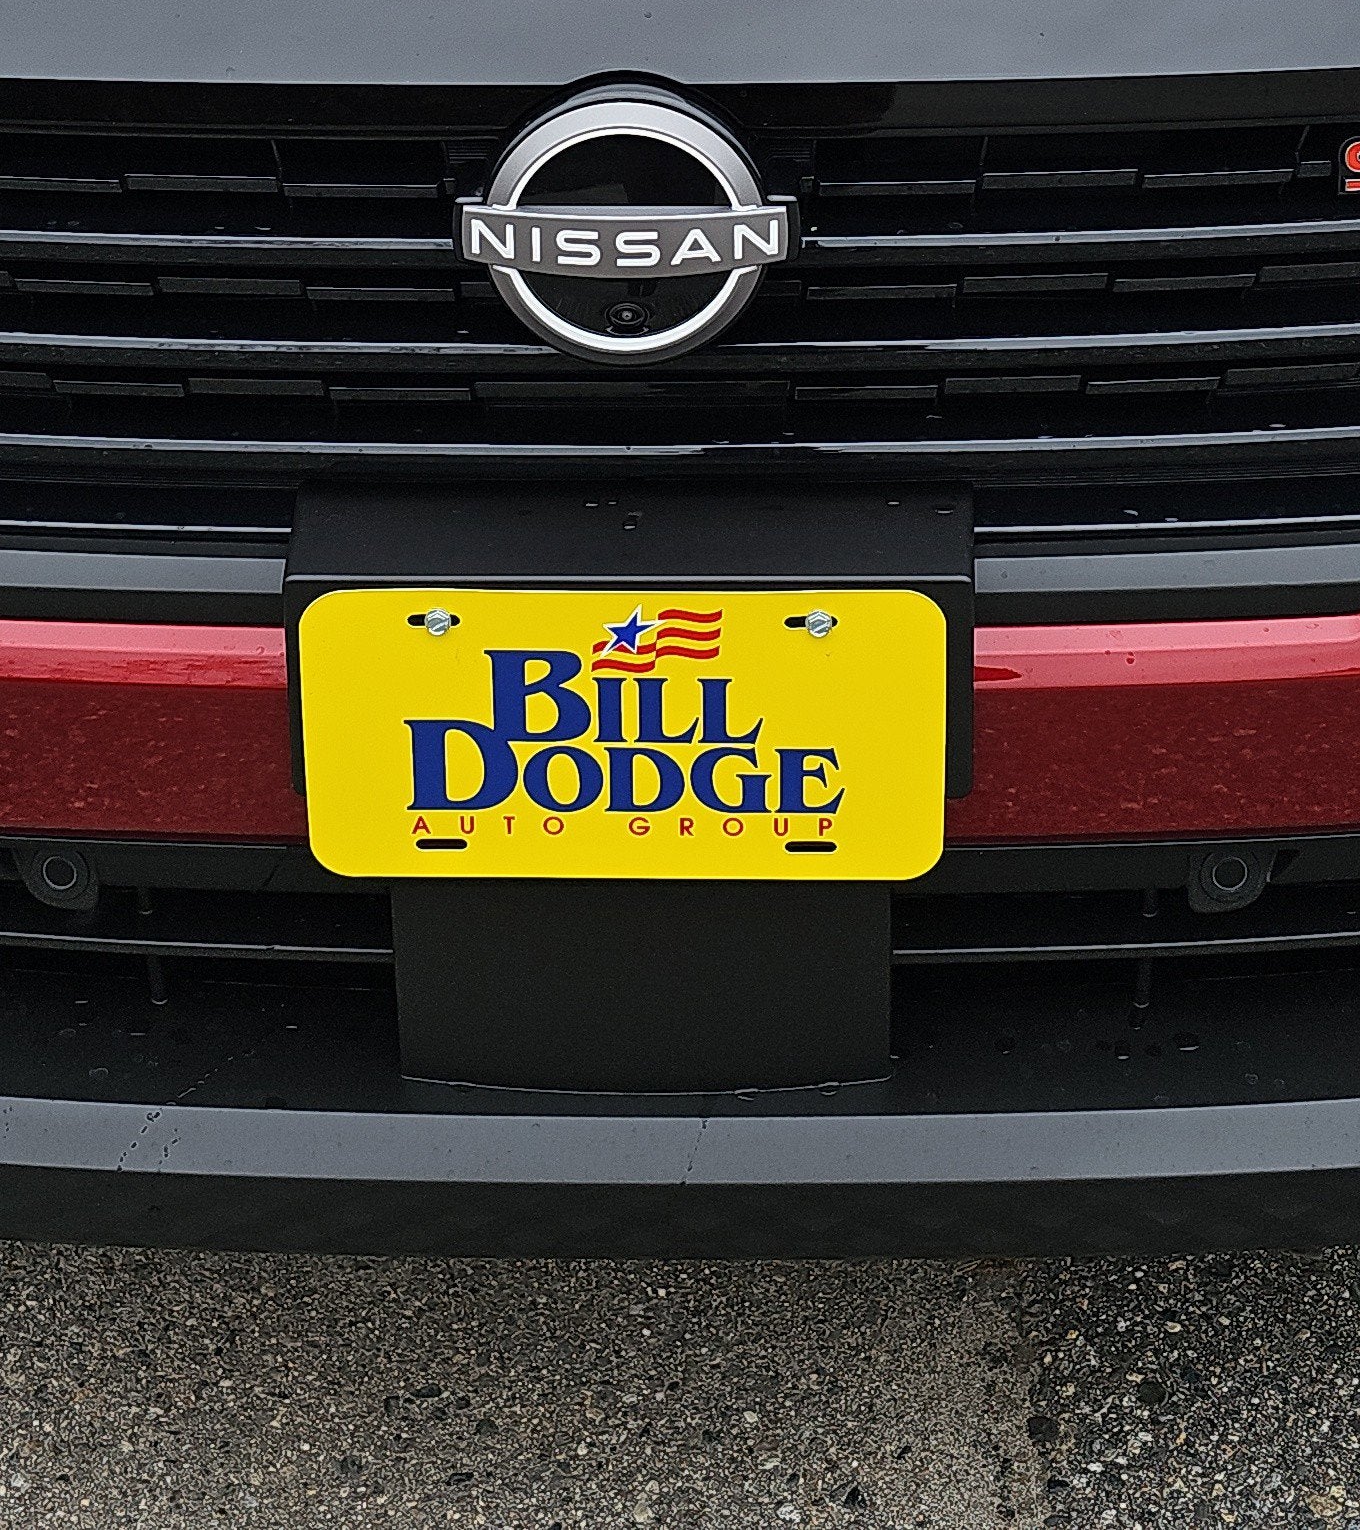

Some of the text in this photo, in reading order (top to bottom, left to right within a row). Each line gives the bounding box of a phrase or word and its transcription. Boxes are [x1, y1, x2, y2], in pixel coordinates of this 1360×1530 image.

[470, 218, 779, 267] NISSAN
[483, 649, 764, 744] BILL
[403, 718, 846, 814] DODGE
[411, 815, 834, 837] AUTO GROUP
